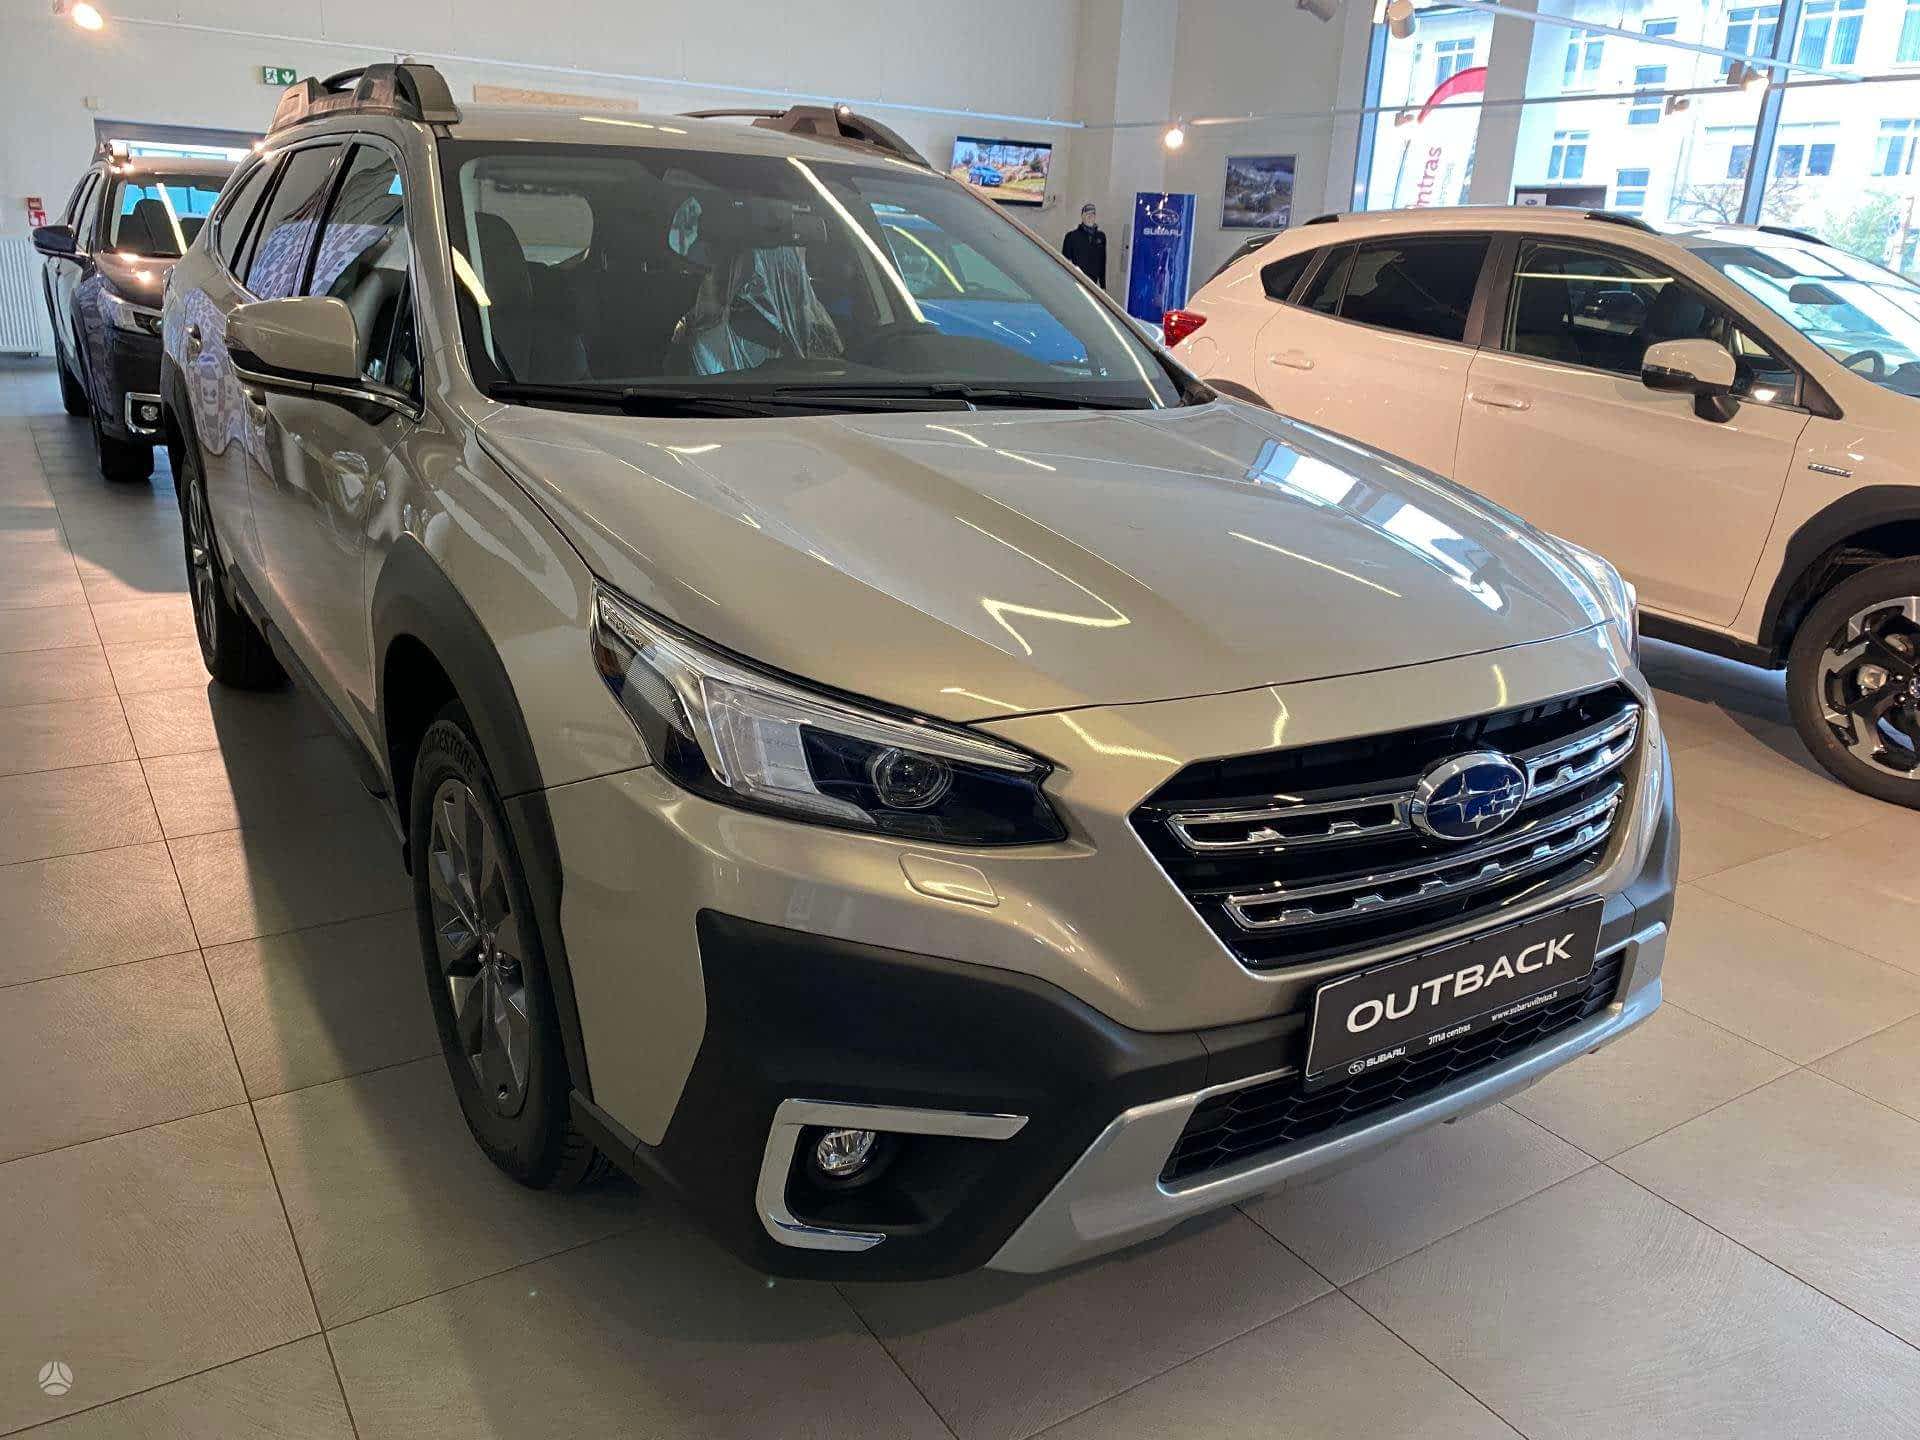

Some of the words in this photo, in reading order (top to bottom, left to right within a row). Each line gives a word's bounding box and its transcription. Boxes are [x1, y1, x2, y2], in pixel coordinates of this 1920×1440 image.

[1416, 146, 1442, 207] ntras
[1143, 227, 1183, 237] SUBARU
[1346, 932, 1575, 1033] OUTBACK
[1365, 1046, 1407, 1068] SUBARU
